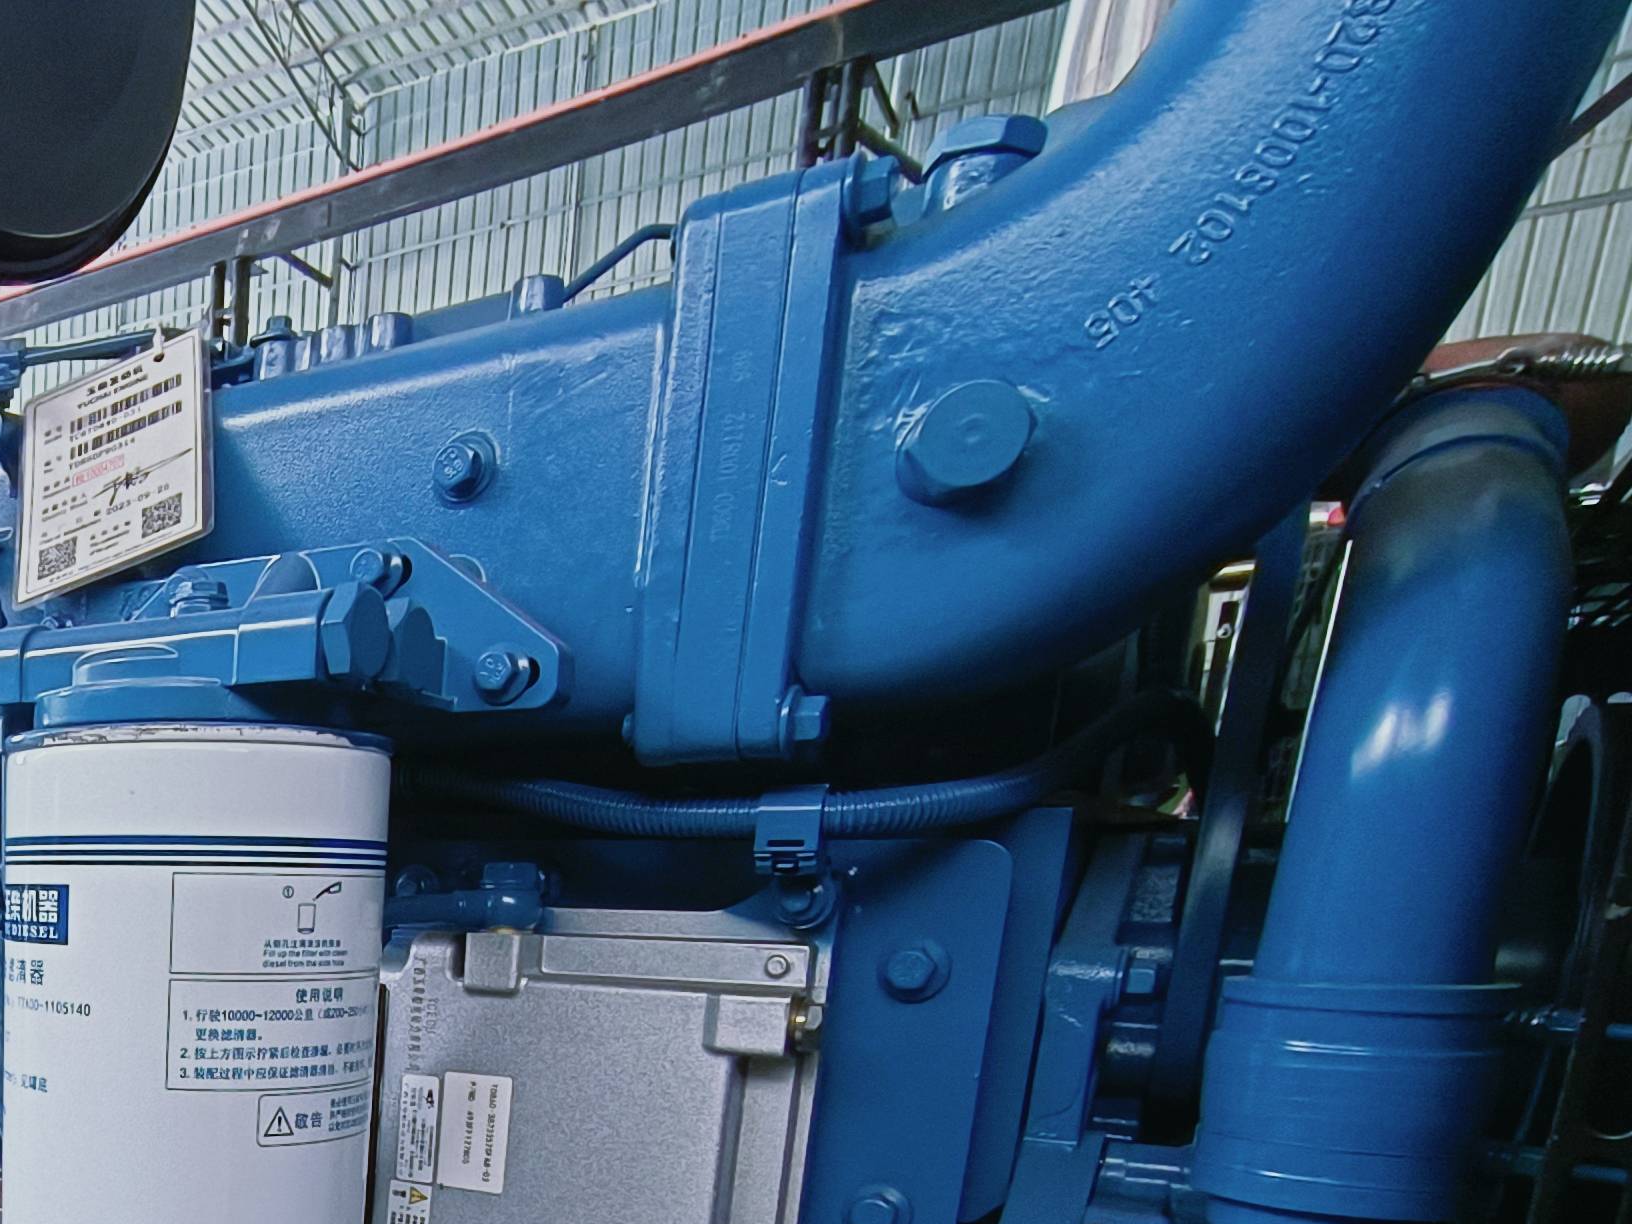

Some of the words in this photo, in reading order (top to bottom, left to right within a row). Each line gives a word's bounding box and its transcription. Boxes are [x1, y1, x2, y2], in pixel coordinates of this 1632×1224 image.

[295, 987, 344, 1003] 使用说明
[295, 1112, 323, 1129] 敬告
